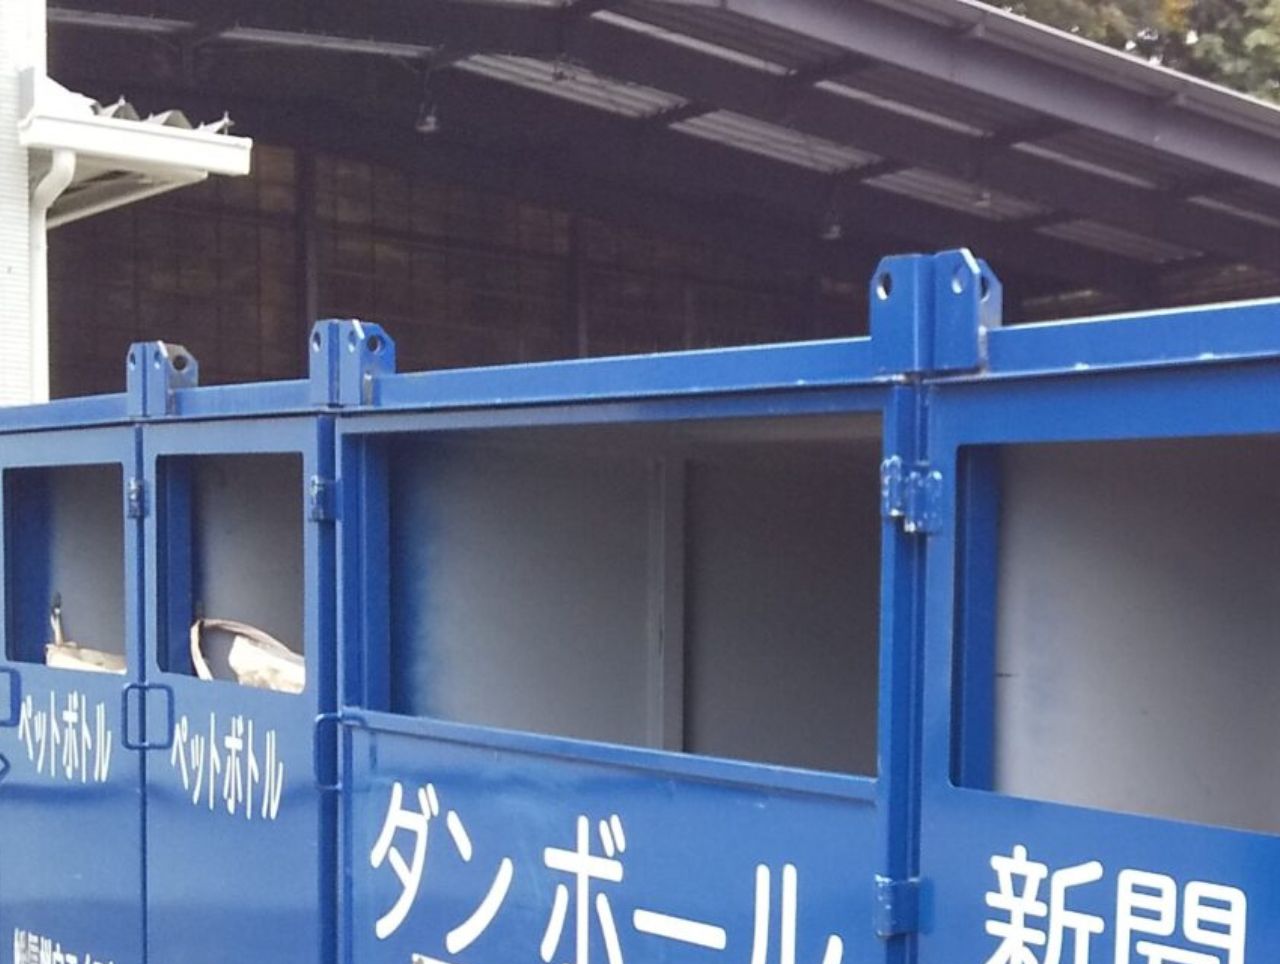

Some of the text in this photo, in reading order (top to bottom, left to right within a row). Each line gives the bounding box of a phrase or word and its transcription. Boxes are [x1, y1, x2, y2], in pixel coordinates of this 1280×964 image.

[18, 690, 112, 783] ペットボトル
[171, 711, 284, 820] ペットボトル
